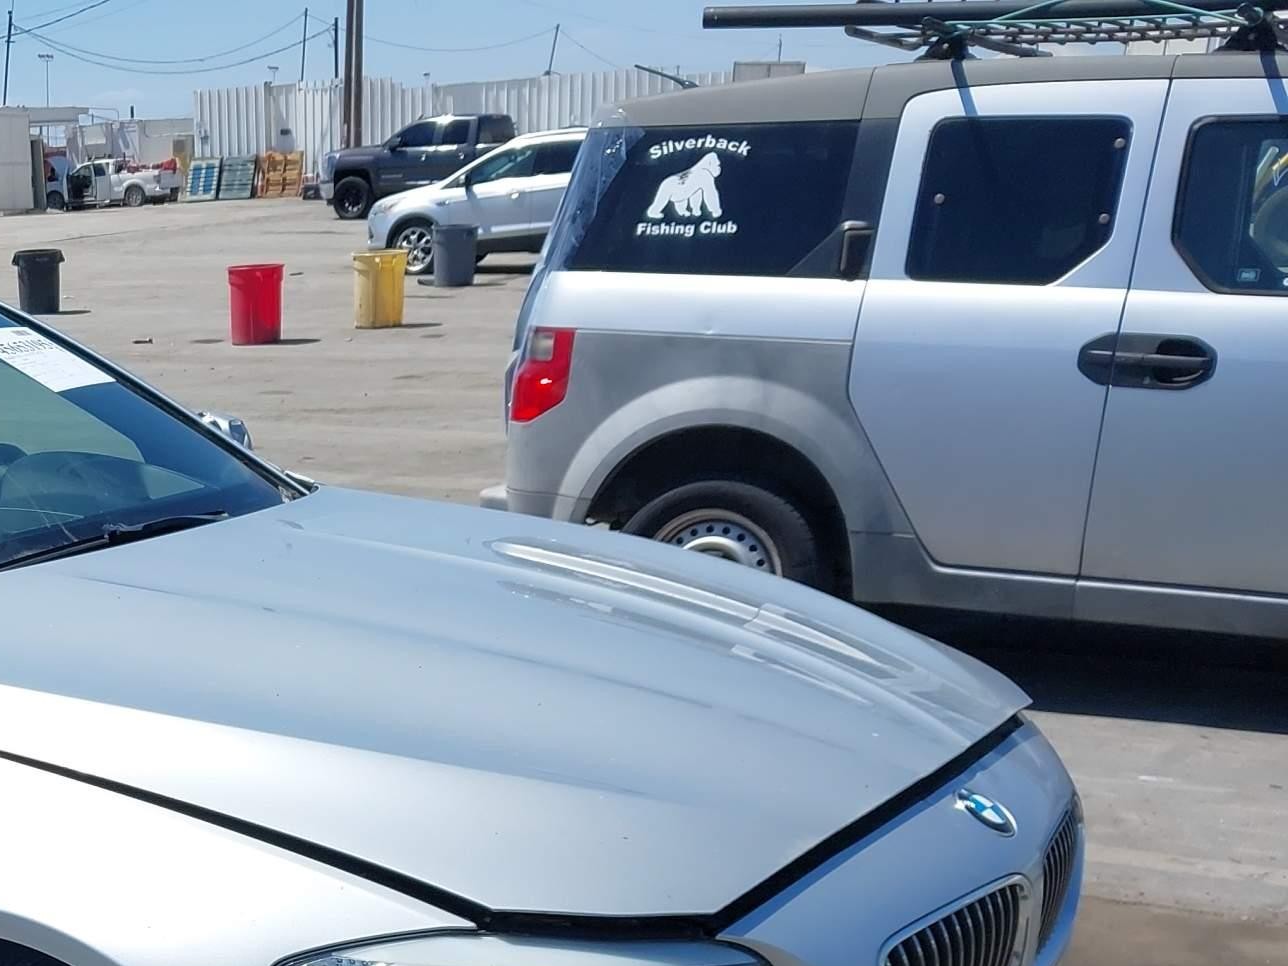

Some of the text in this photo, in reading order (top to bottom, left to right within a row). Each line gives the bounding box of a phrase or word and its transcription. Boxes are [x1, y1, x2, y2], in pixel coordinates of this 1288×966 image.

[649, 134, 751, 158] Silverback
[636, 220, 738, 237] Fishing Club
